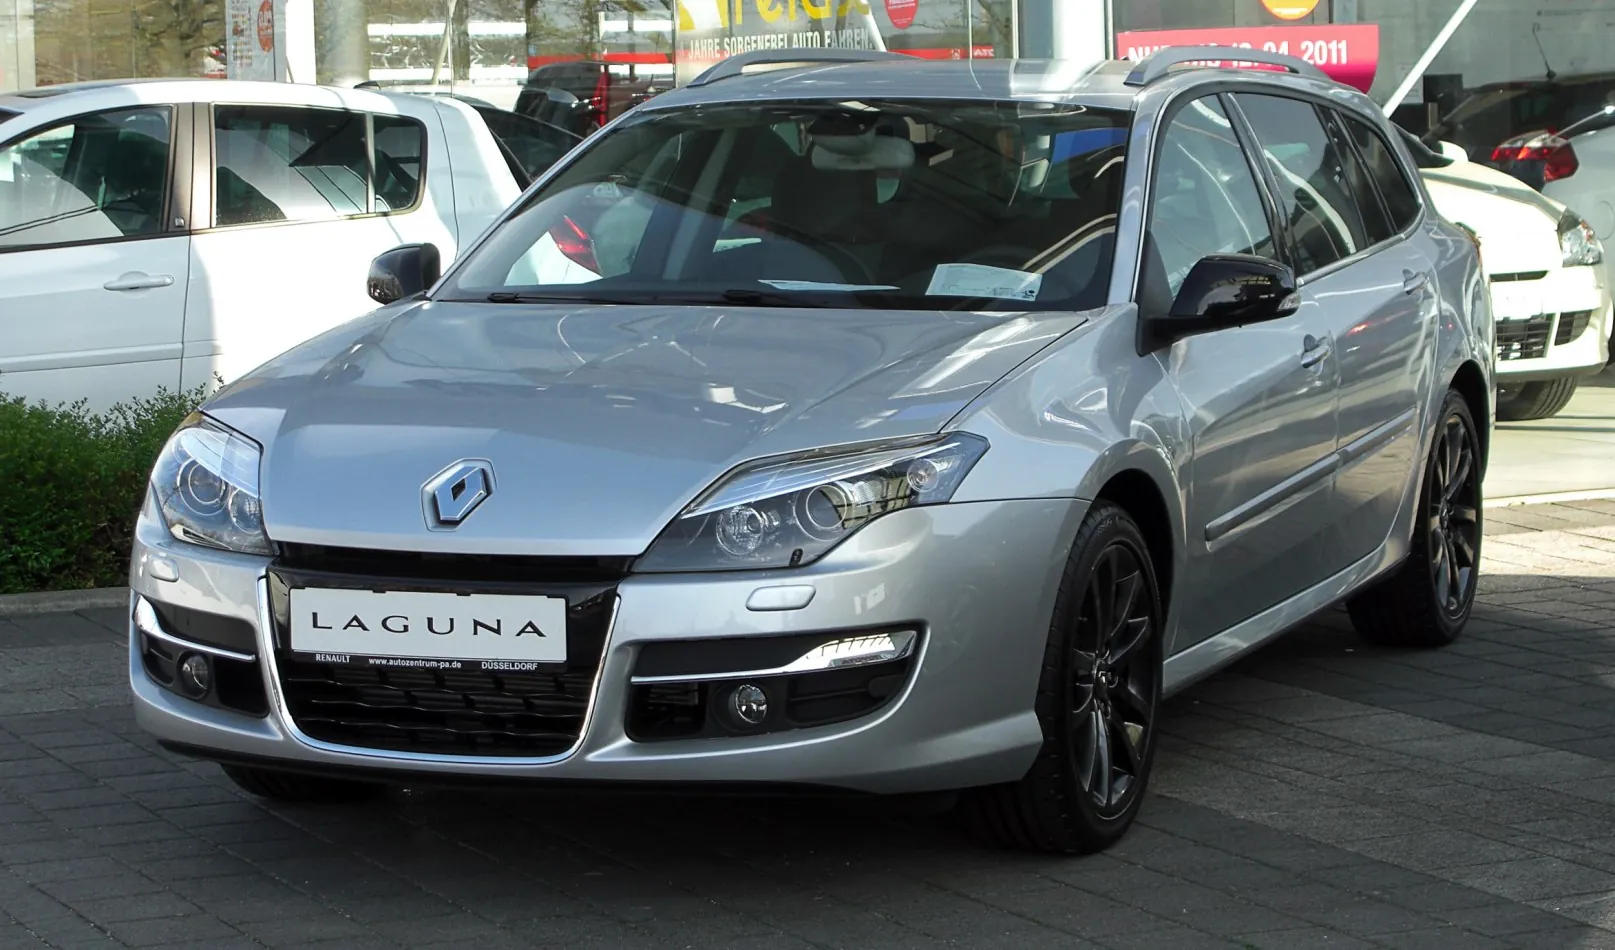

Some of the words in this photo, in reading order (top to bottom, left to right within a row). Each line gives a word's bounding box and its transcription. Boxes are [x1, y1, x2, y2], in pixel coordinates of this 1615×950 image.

[688, 38, 721, 59] JAHRE
[723, 33, 788, 58] SORGENFREI
[792, 30, 821, 49] AUTO
[1301, 39, 1347, 65] 2011
[312, 611, 547, 638] LAGUNA
[315, 653, 351, 663] RENAULT
[368, 656, 462, 669] www.autozentrum-pa.de
[481, 660, 538, 671] DÜSSELDORF
